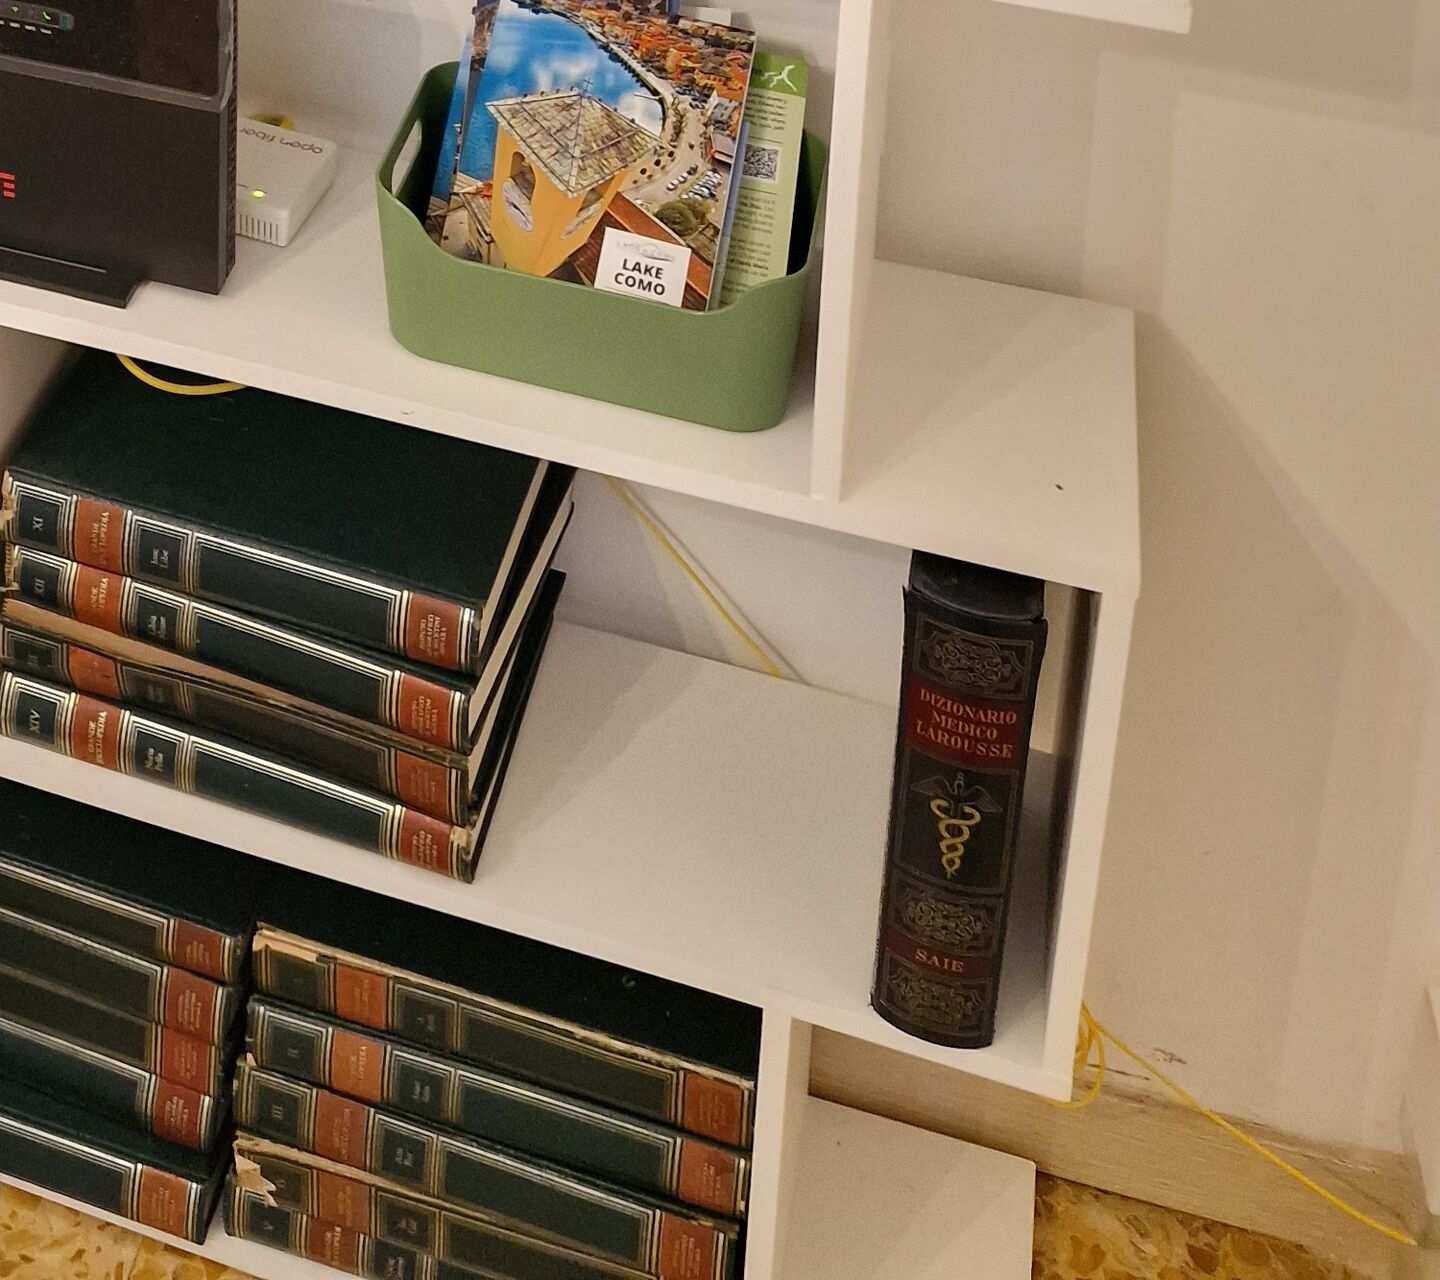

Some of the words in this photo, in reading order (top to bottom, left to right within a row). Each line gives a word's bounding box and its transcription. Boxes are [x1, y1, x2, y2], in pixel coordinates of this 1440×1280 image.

[279, 138, 323, 154] open
[622, 258, 664, 280] LAKE
[614, 272, 666, 296] COMO
[32, 516, 44, 531] XI
[918, 687, 1019, 726] DIZIONARIO
[29, 708, 42, 732] XIV
[929, 707, 999, 741] MEDICO
[915, 724, 1015, 760] LAROUSSE
[914, 948, 966, 974] SAIE
